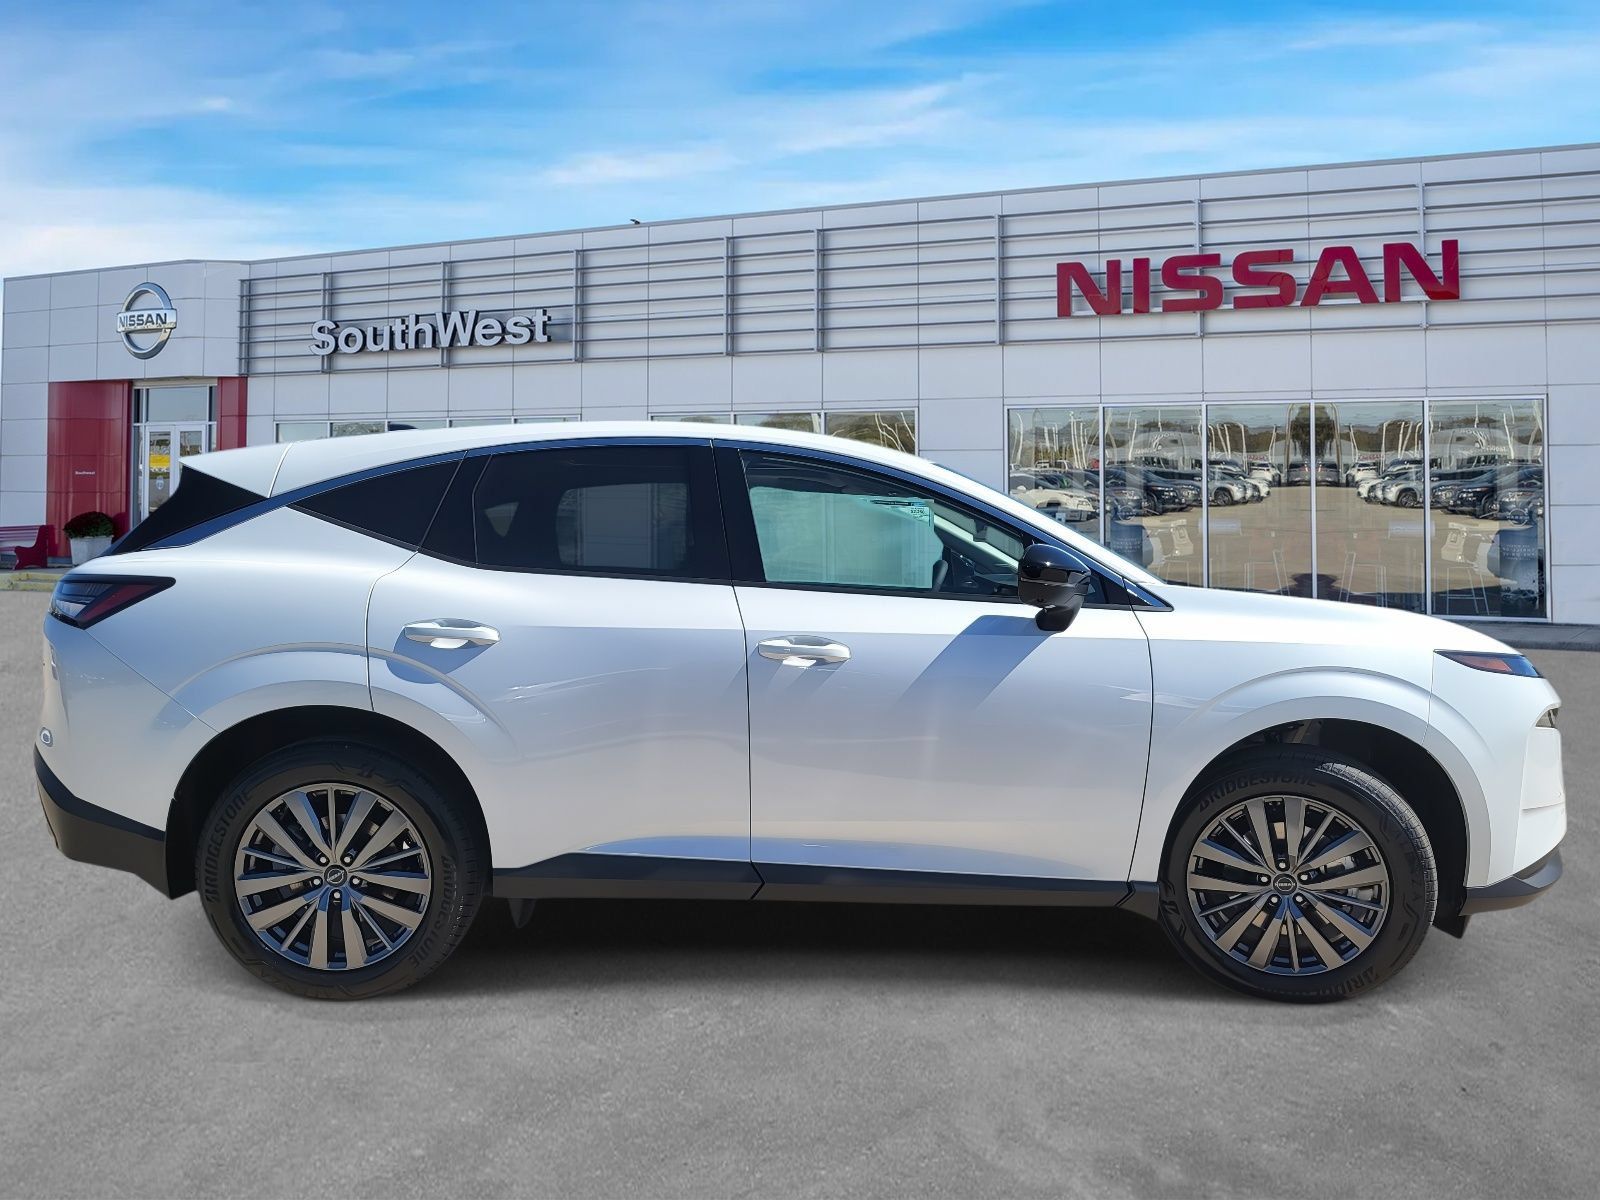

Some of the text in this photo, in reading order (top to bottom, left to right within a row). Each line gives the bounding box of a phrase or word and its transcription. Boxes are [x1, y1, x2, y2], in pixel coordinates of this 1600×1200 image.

[1057, 239, 1460, 317] NISSAN
[119, 312, 167, 328] NISSAN
[309, 308, 551, 355] SouthWest
